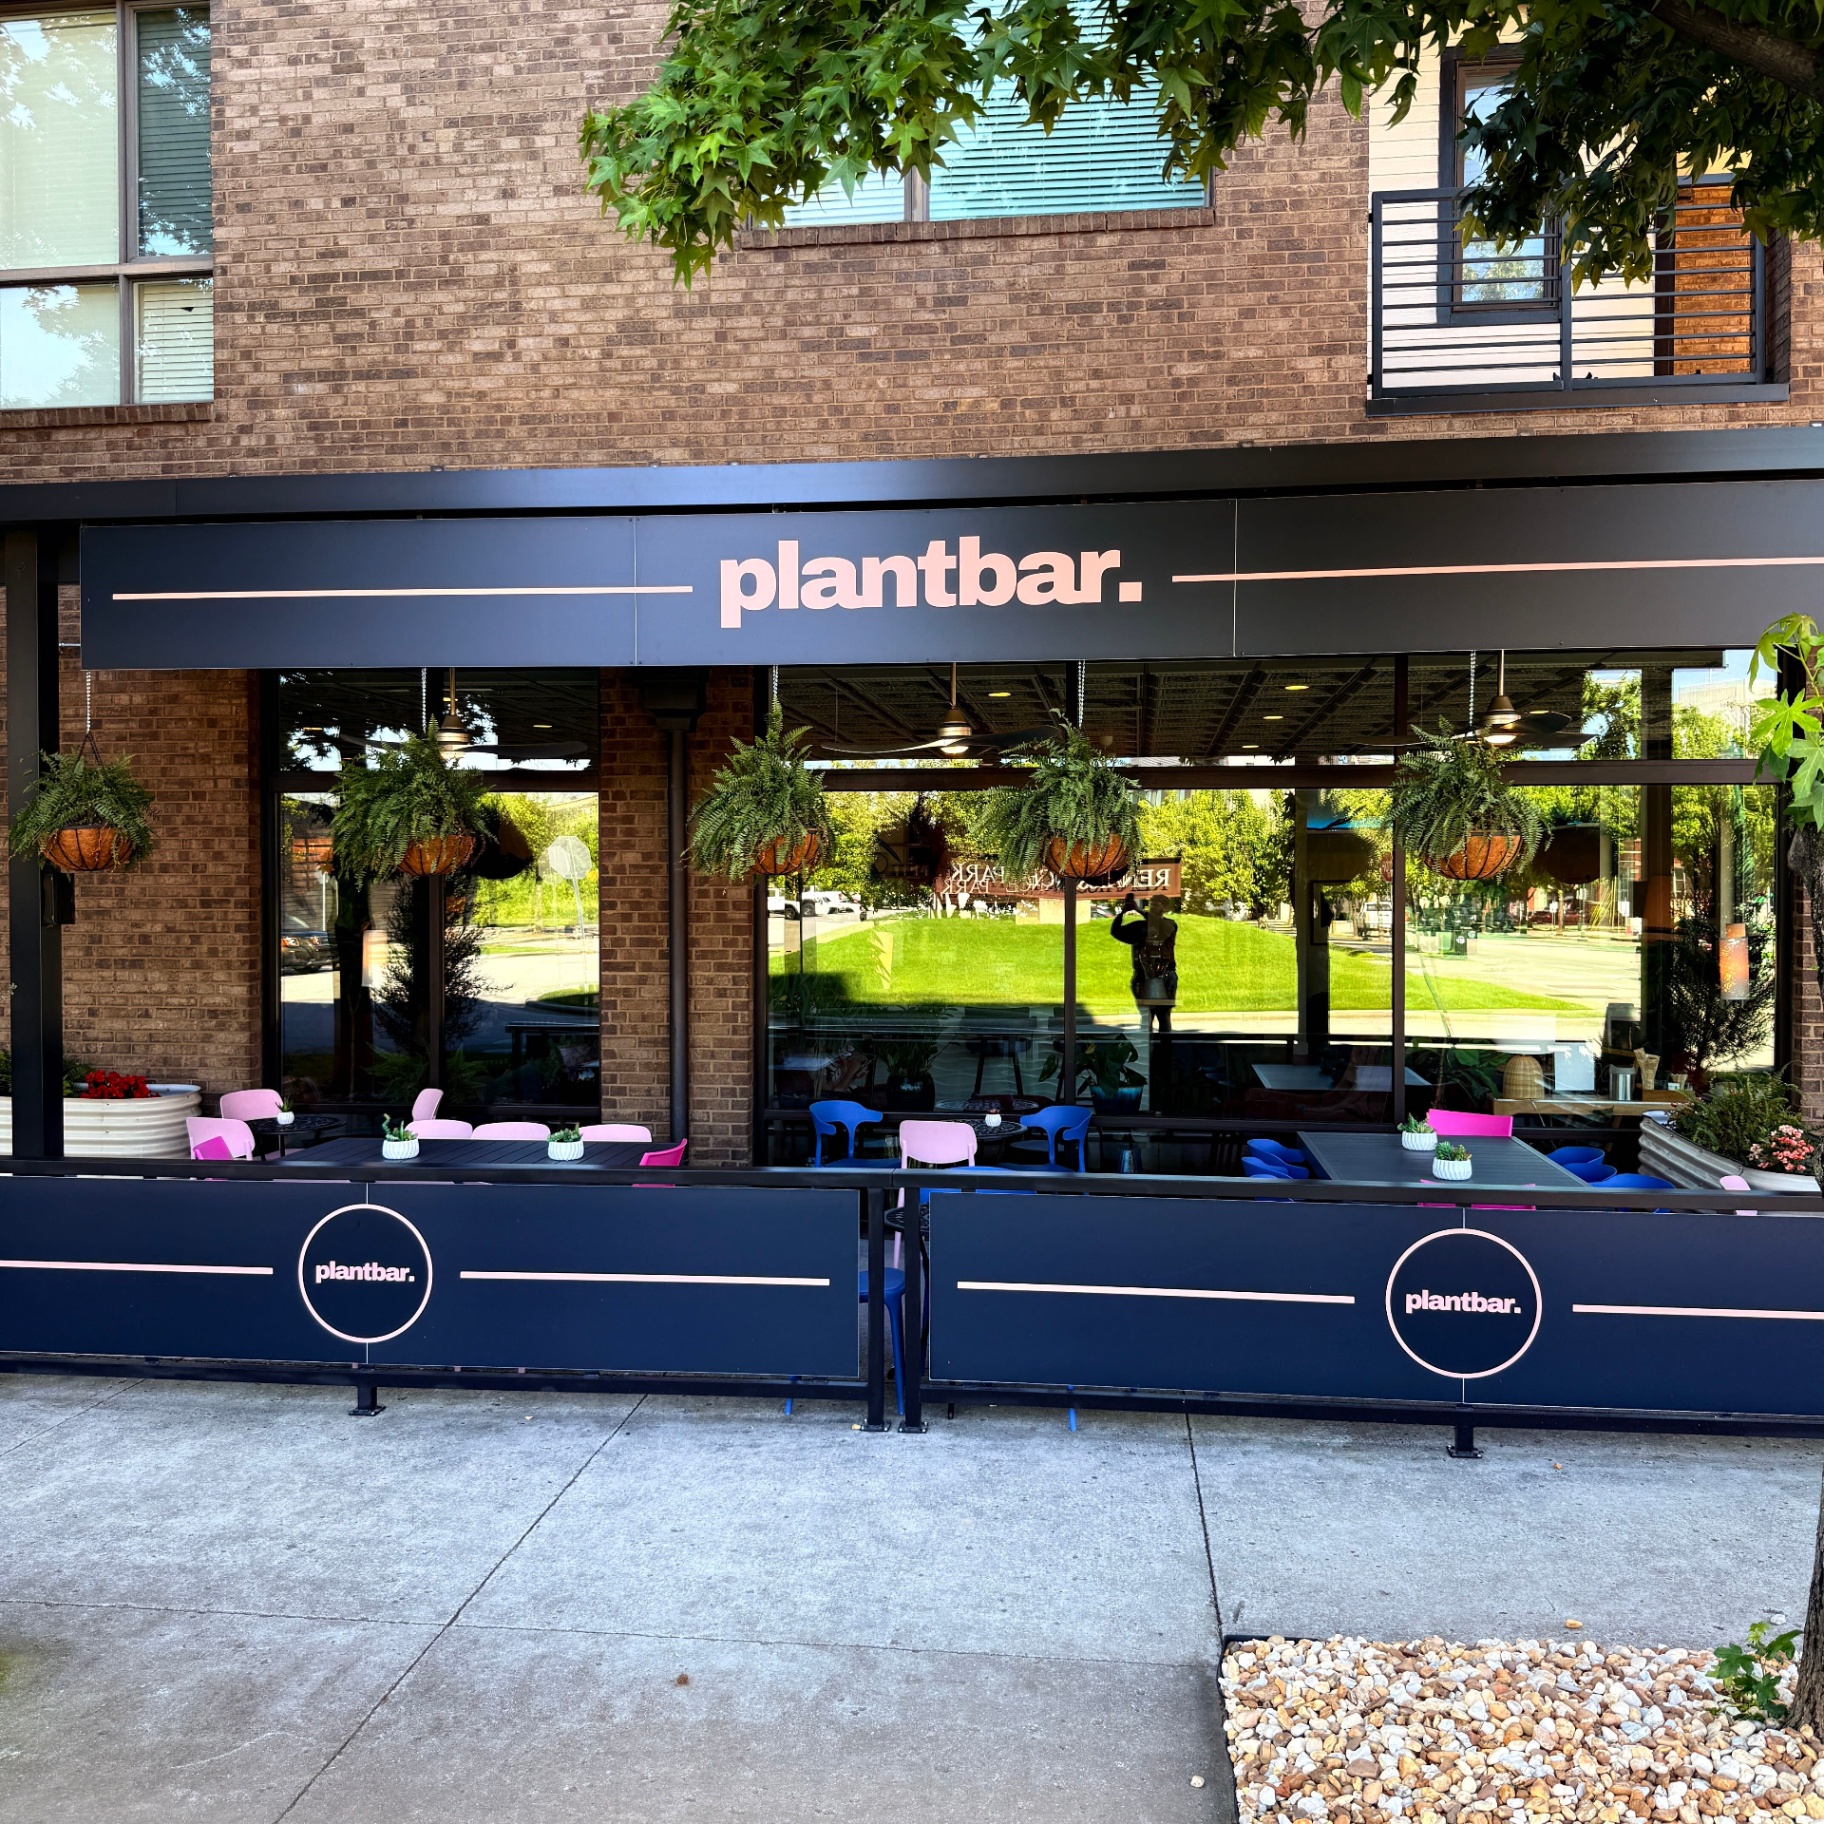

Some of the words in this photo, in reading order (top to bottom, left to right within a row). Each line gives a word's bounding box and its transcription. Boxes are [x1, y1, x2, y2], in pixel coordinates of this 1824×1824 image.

[720, 536, 1142, 628] plantbar.
[315, 1260, 415, 1284] plantbar.
[1405, 1289, 1522, 1314] plantbar.
